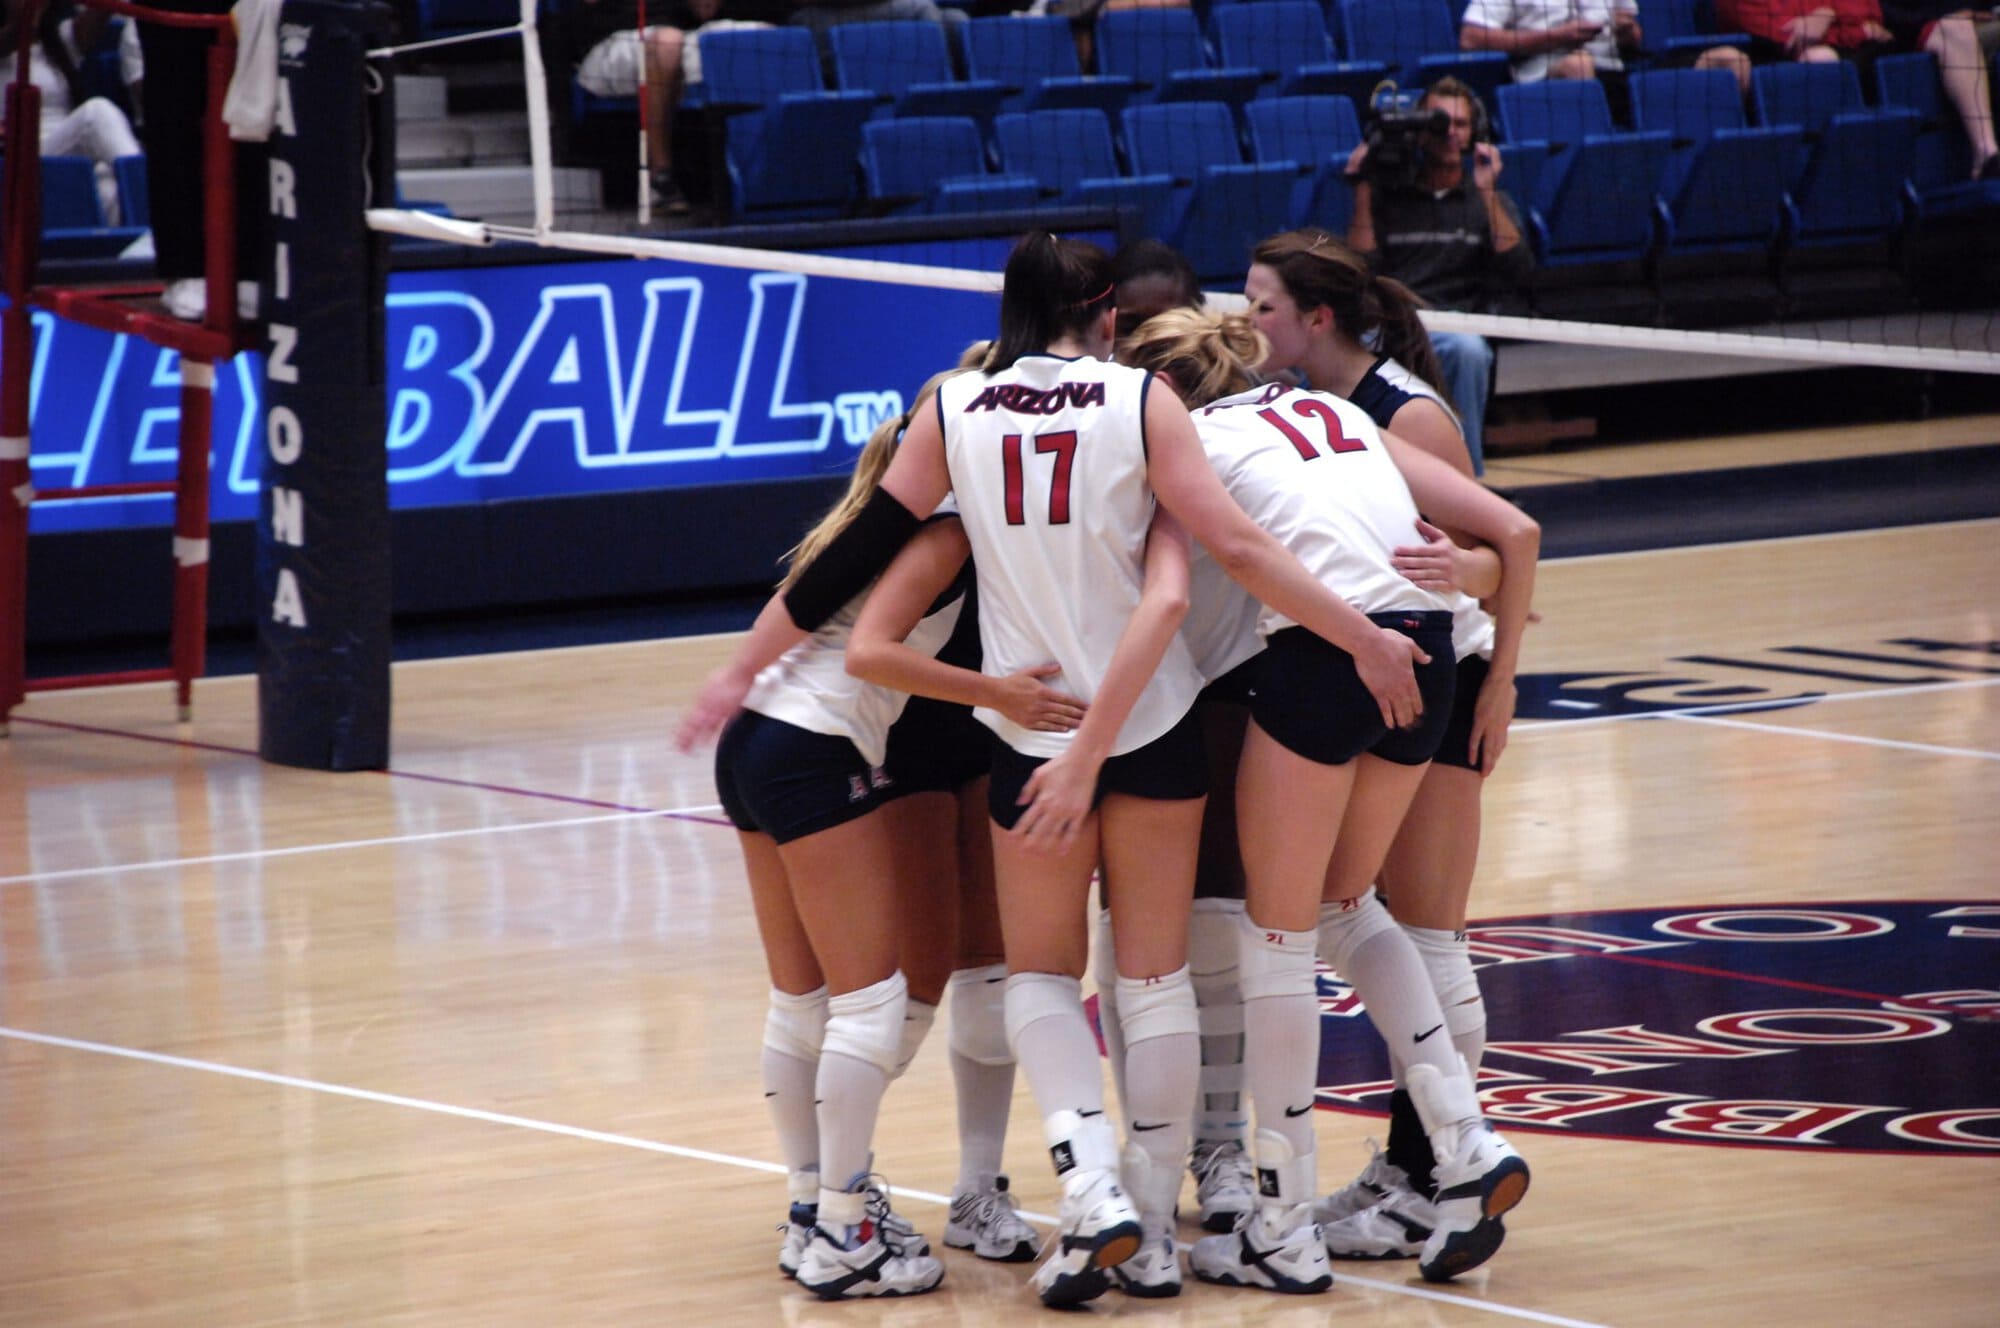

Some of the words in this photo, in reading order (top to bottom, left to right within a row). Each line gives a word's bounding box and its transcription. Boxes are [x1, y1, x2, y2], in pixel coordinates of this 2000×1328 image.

[964, 381, 1105, 416] ARIZONA
[1256, 399, 1367, 461] 12
[1002, 430, 1077, 525] 17
